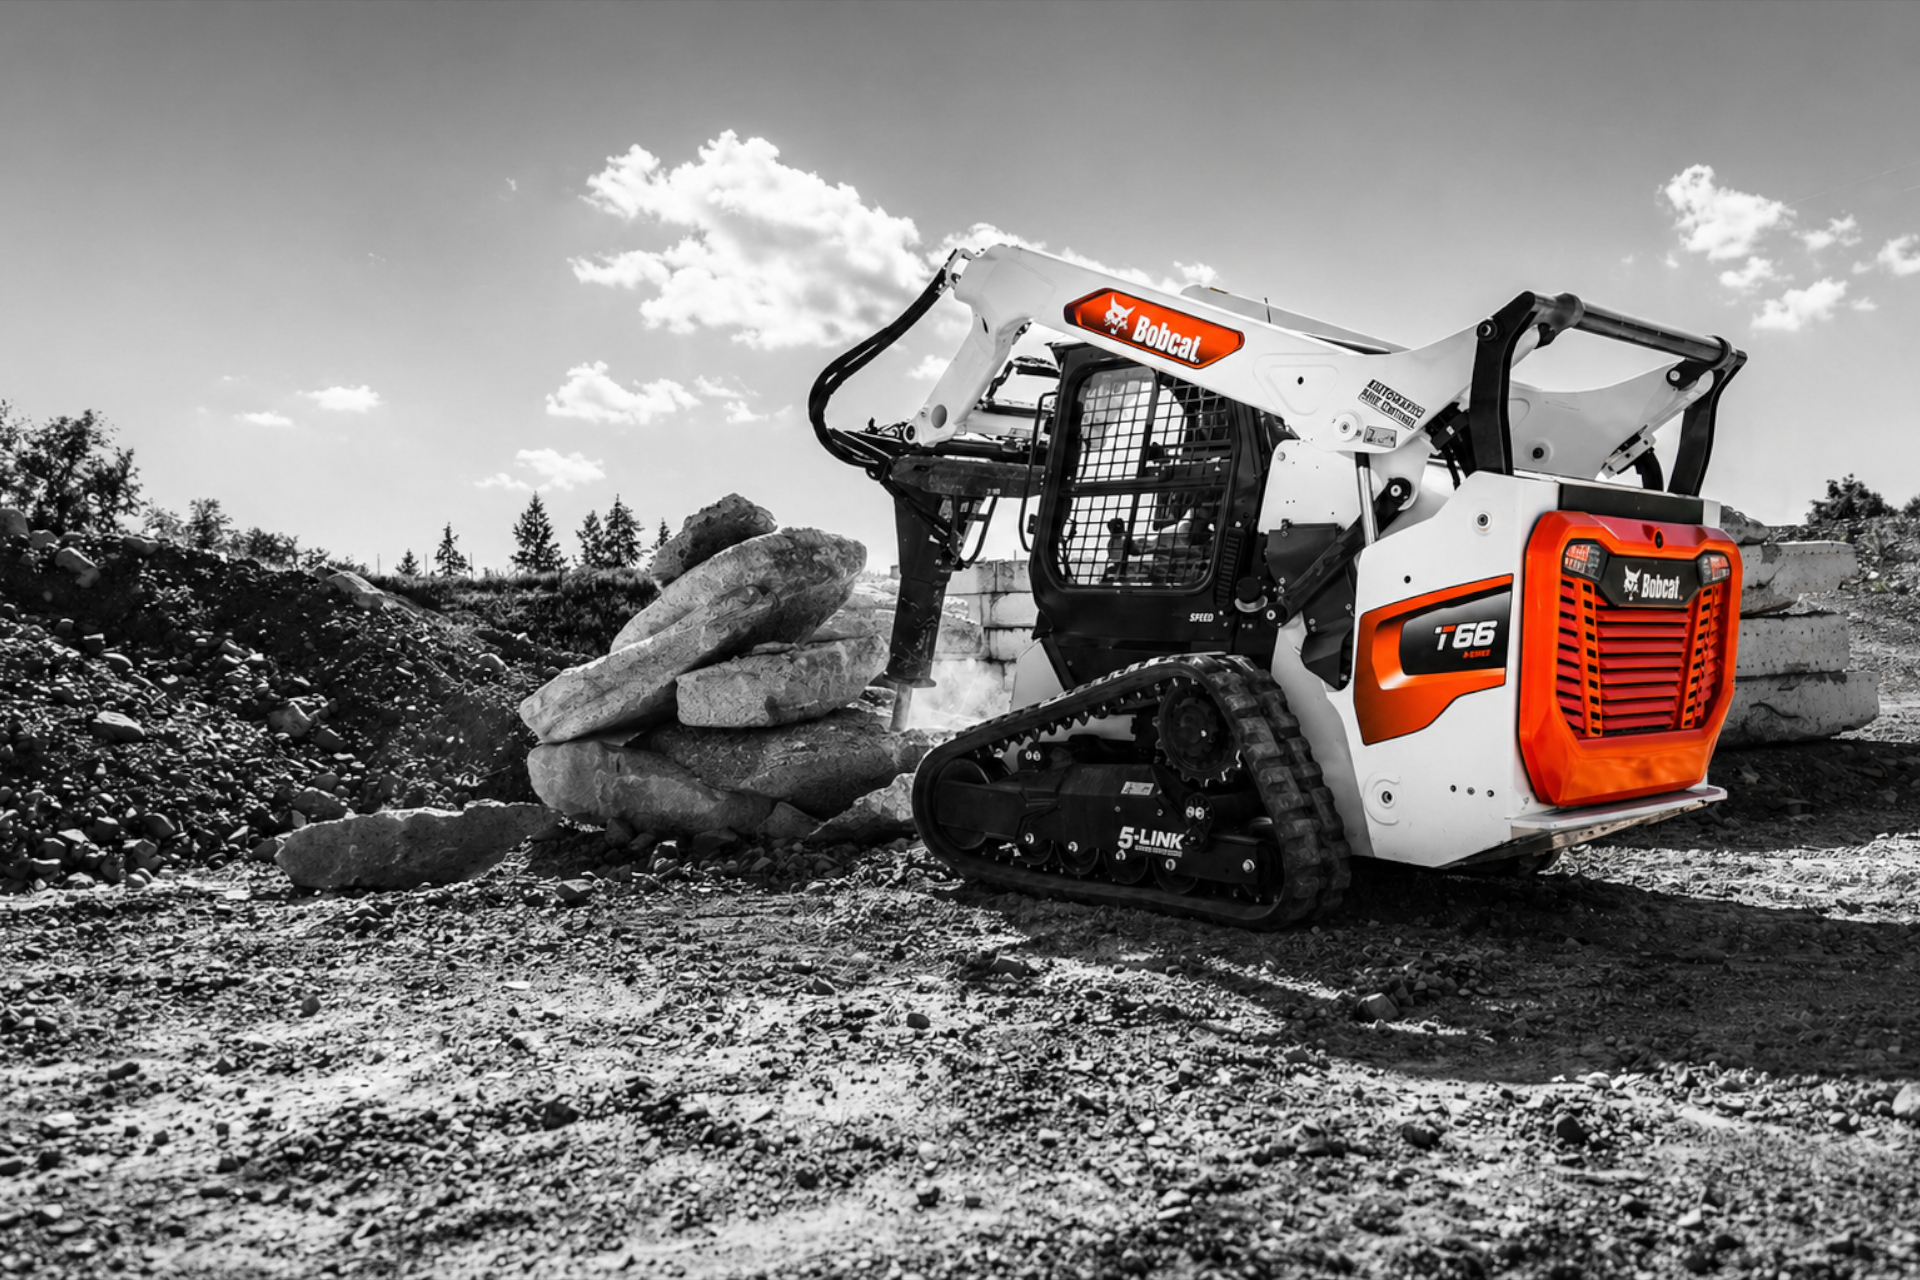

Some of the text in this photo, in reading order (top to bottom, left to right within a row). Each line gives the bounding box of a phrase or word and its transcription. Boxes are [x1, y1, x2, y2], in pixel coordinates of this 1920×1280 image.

[1132, 315, 1202, 362] Bobcat
[1641, 573, 1680, 600] Bobcat
[1189, 612, 1215, 623] SPEED
[1434, 620, 1498, 651] T66
[1117, 825, 1185, 850] 5-LINK
